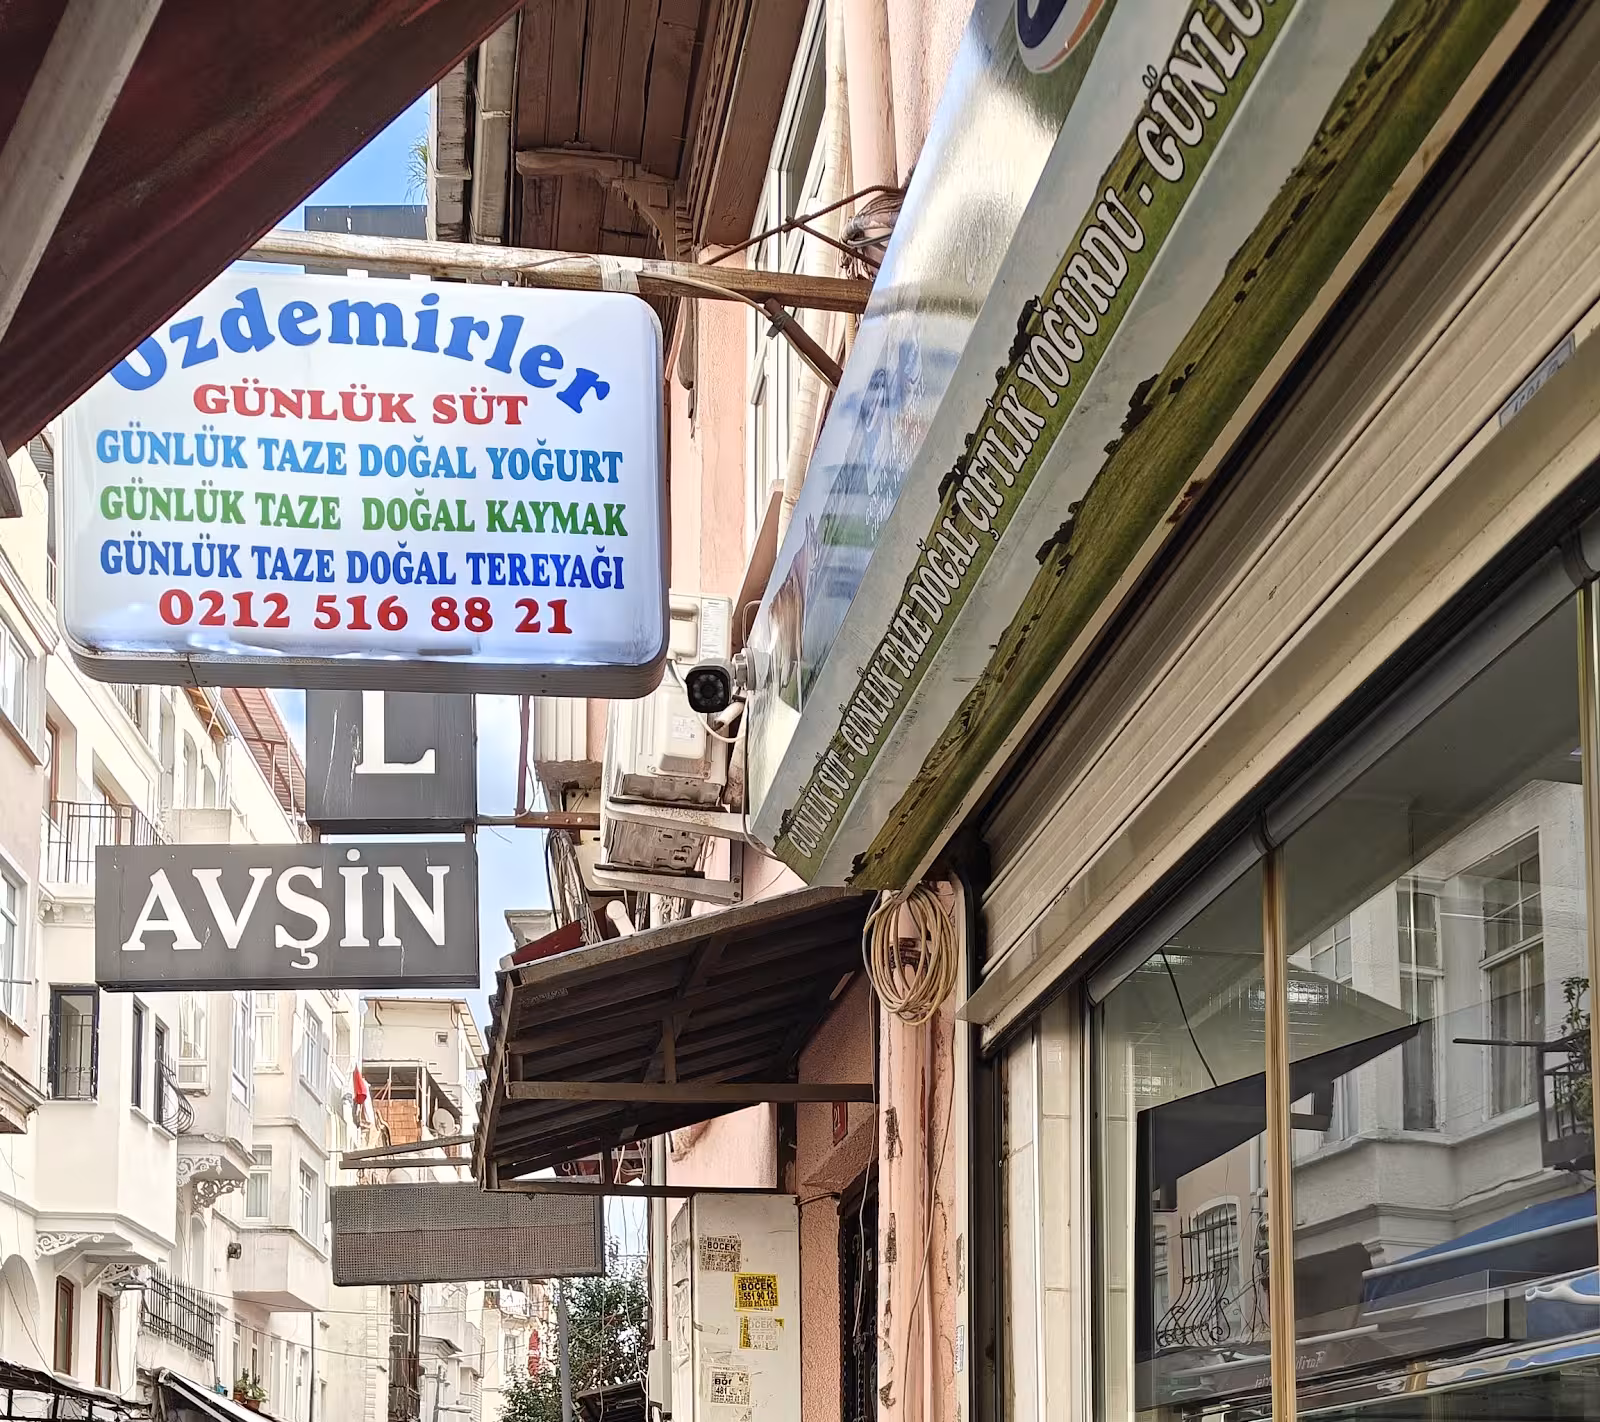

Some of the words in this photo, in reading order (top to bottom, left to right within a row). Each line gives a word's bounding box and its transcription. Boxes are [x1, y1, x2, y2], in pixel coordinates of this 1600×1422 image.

[193, 377, 417, 424] GÜNLÜK
[432, 387, 529, 425] SÜT
[838, 660, 903, 756] GÜNLÜK
[880, 603, 934, 678] TAZE
[909, 516, 980, 625] DOĞAL
[955, 384, 1046, 541] ÇİFTLİK
[1016, 186, 1145, 408] YOĞURDU
[1137, 0, 1277, 182] GÜNL
[96, 422, 247, 468] GÜNLÜK
[257, 437, 347, 476] TAZE
[358, 435, 477, 480] DOĞAL
[486, 438, 624, 484] YOĞURT
[100, 478, 245, 524] GÜNLÜK
[255, 493, 341, 531] TAZE
[362, 490, 475, 533] DOĞAL
[486, 499, 628, 537] KAYMAK
[100, 532, 243, 578] GÜNLÜK
[251, 545, 336, 583] TAZE
[346, 541, 457, 586] DOĞAL
[465, 545, 625, 590] TEREYAĞI
[159, 589, 291, 628] 0212
[313, 595, 409, 631] 516
[430, 596, 493, 633] 88
[515, 598, 573, 634] 21
[121, 848, 451, 969] AVŞİN
